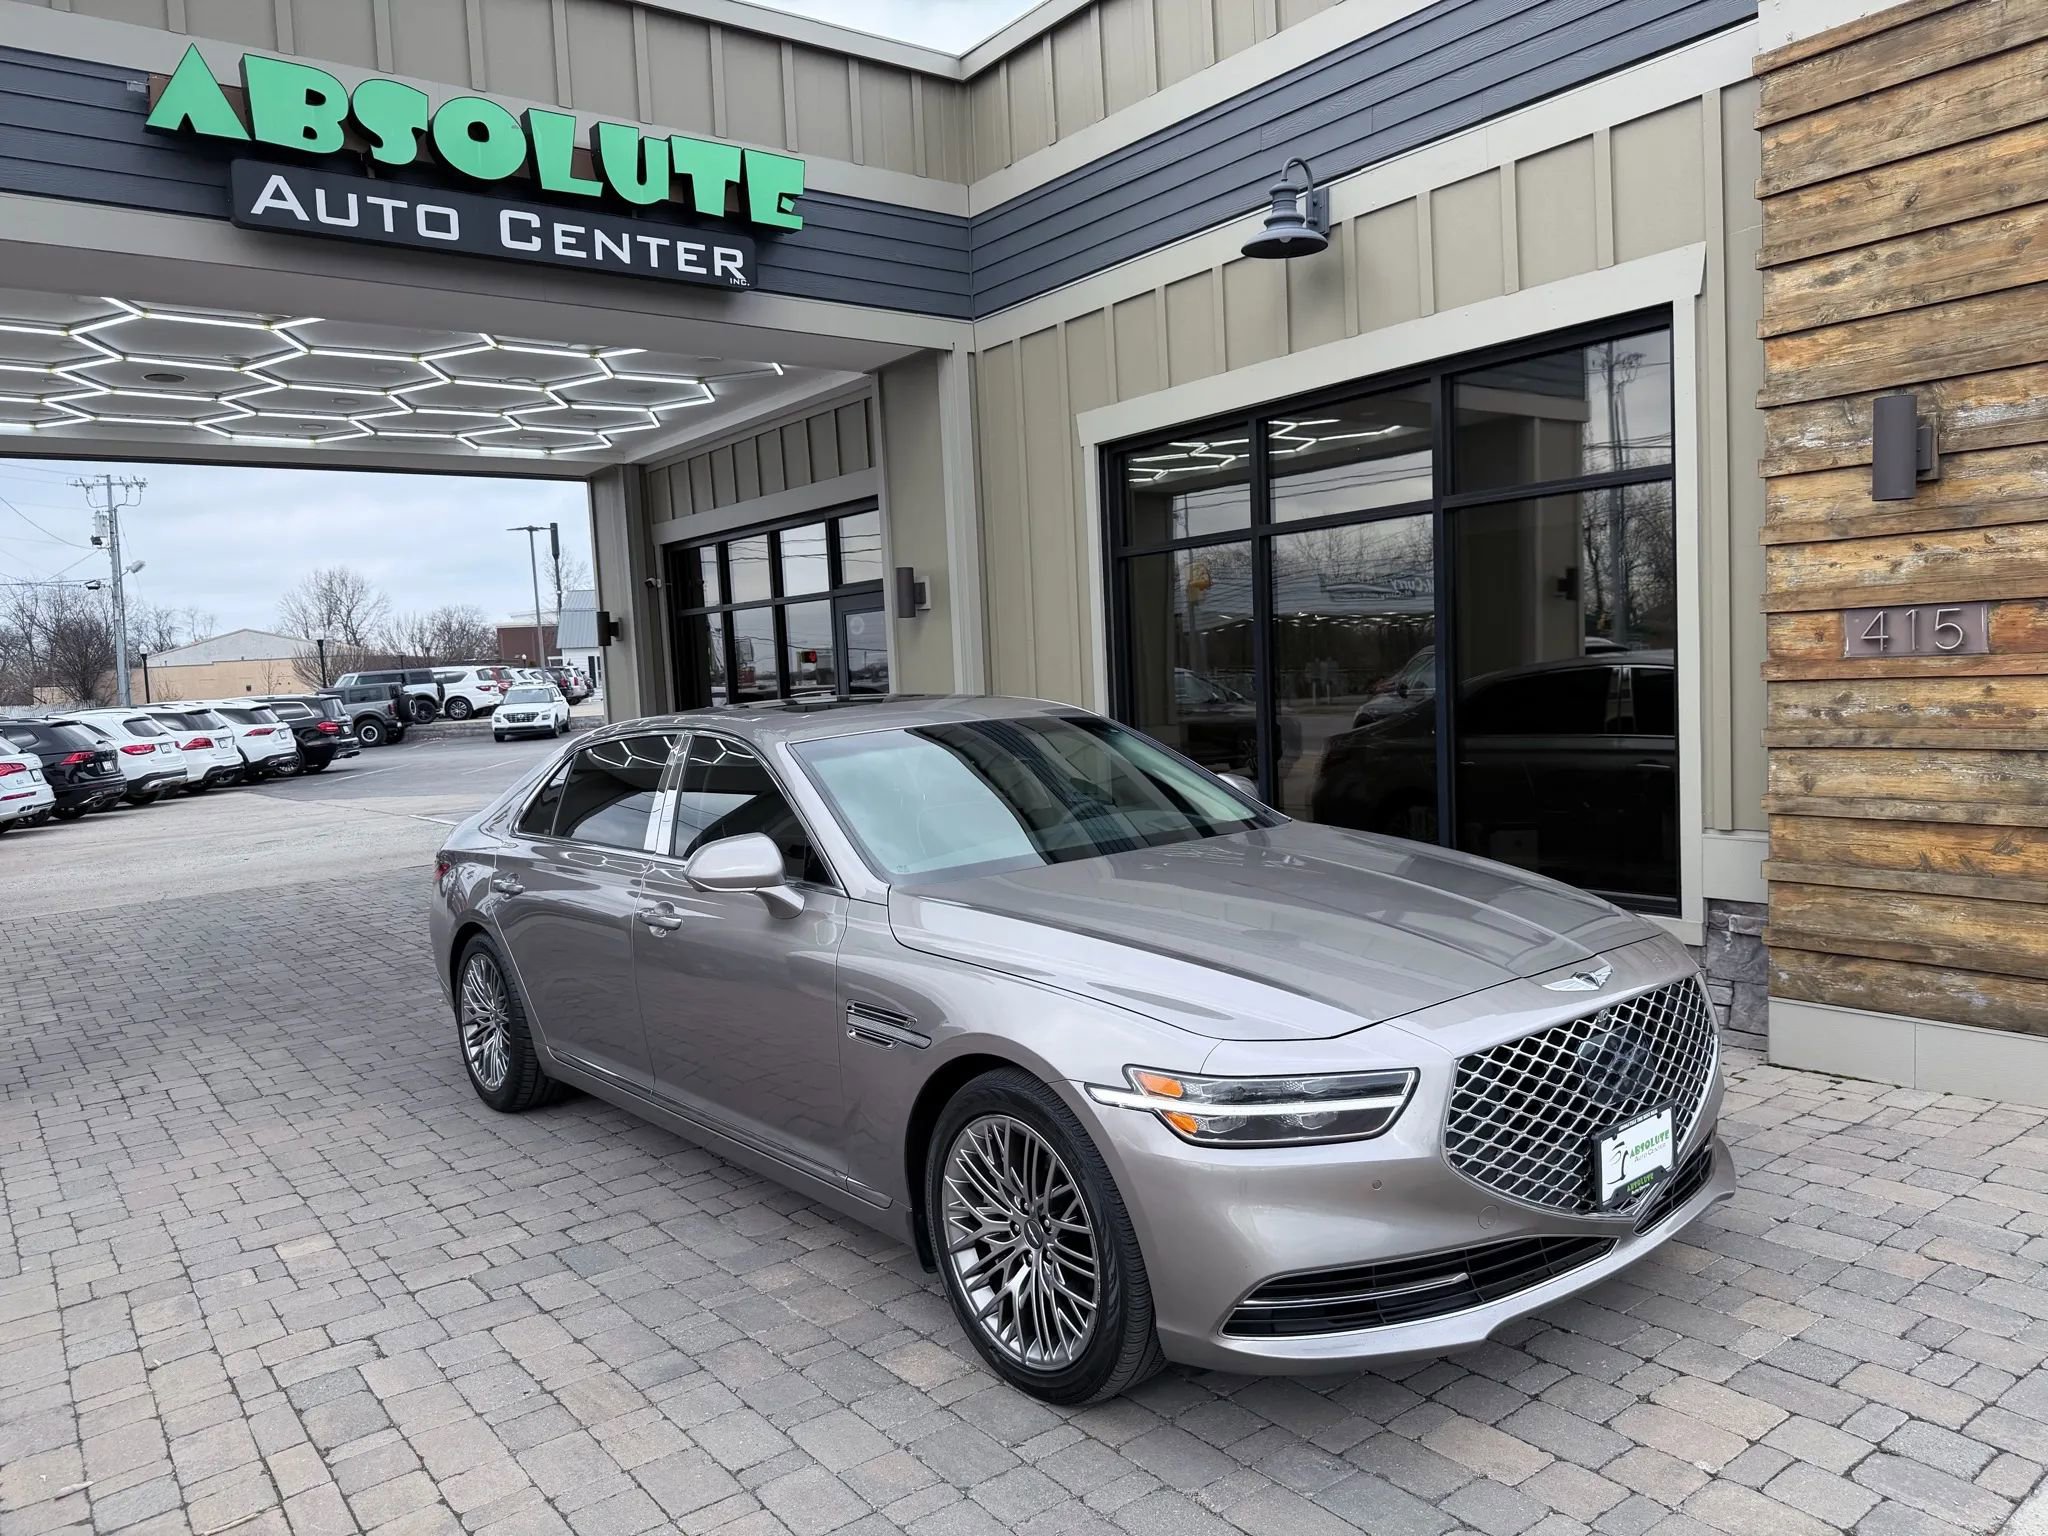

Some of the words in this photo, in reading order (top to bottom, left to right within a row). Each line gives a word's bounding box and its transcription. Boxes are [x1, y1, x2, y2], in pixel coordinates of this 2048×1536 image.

[145, 42, 805, 231] ABSOLUTE
[251, 174, 460, 242] AUTO
[500, 209, 747, 280] CENTER
[729, 277, 750, 286] INC.
[1860, 608, 1964, 651] 415
